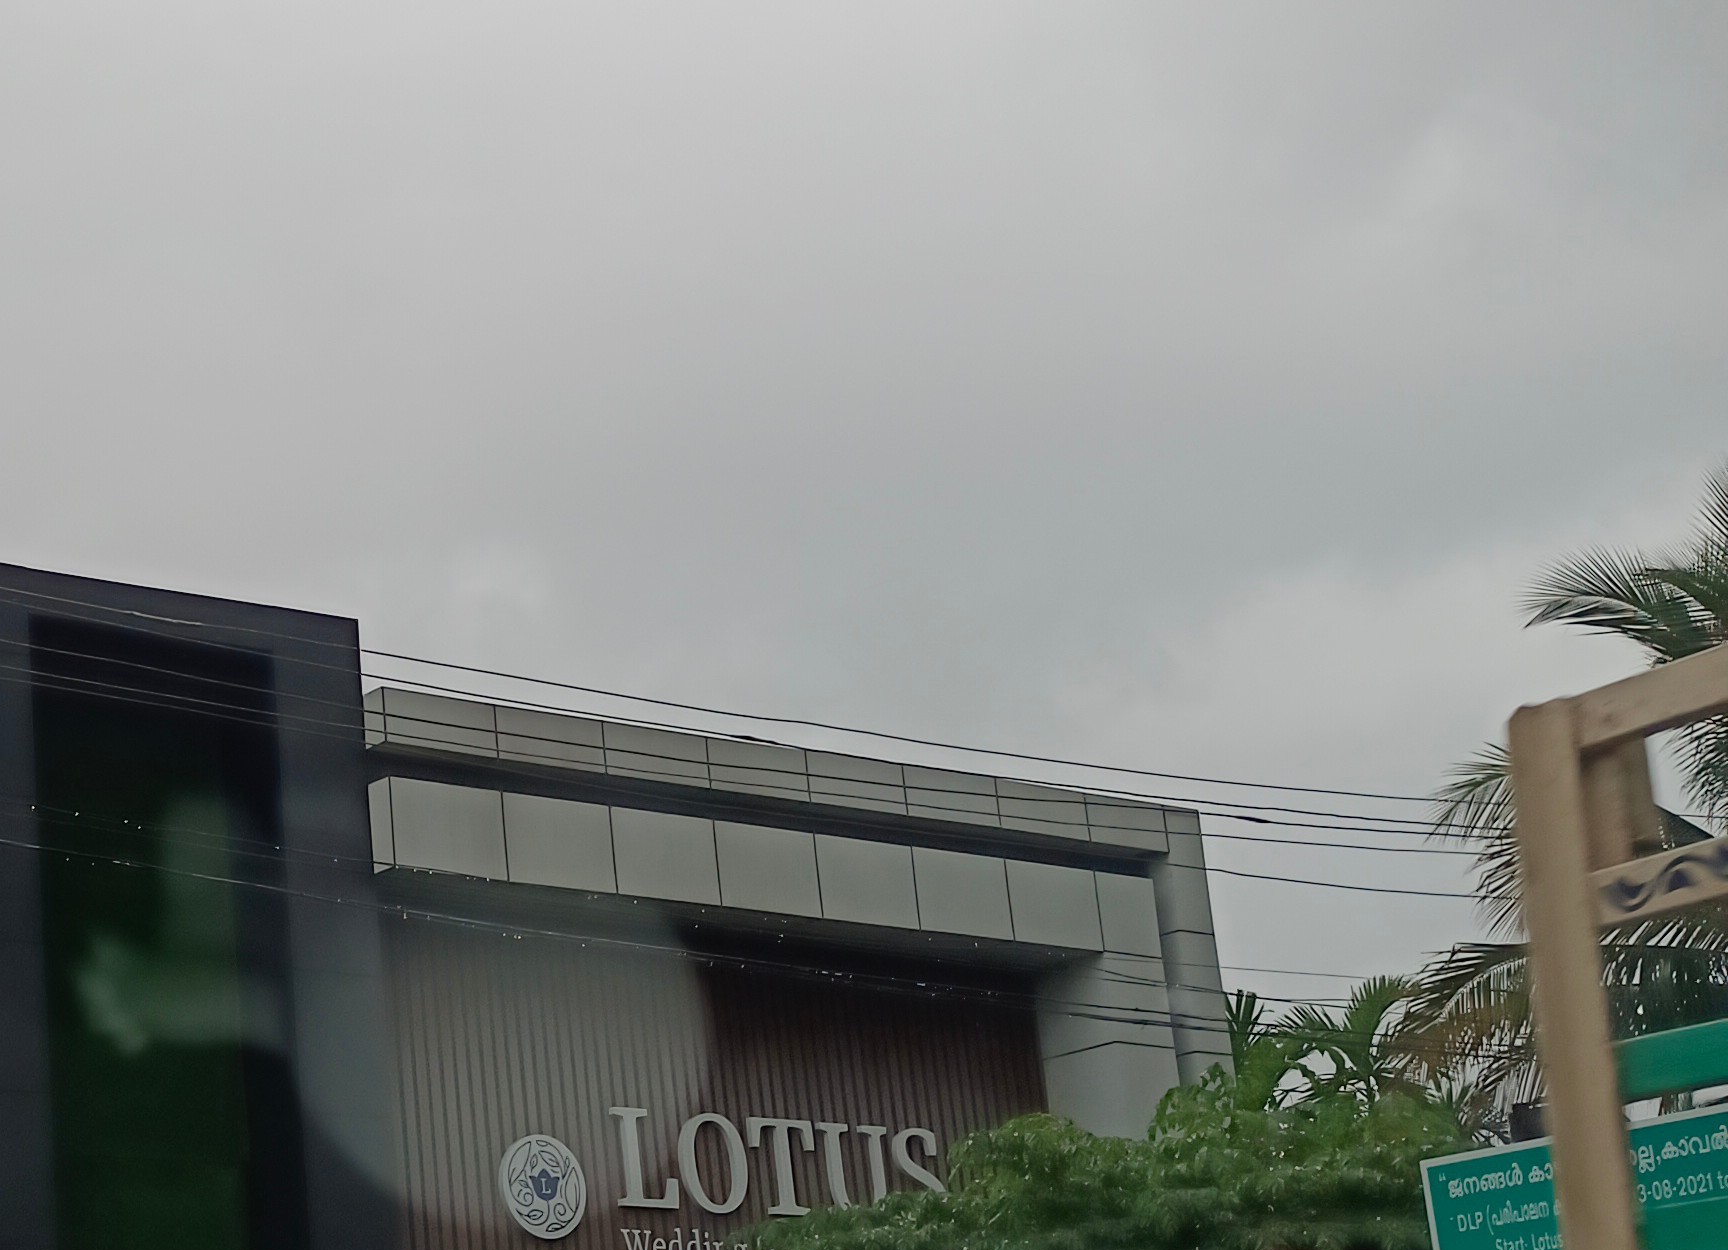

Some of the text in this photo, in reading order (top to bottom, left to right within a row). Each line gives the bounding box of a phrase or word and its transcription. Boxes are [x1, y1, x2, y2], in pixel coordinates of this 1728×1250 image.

[540, 1178, 552, 1194] L
[609, 1106, 947, 1217] LOTUS
[1456, 1211, 1484, 1233] DLP
[1636, 1173, 1714, 1203] 3-08-2021
